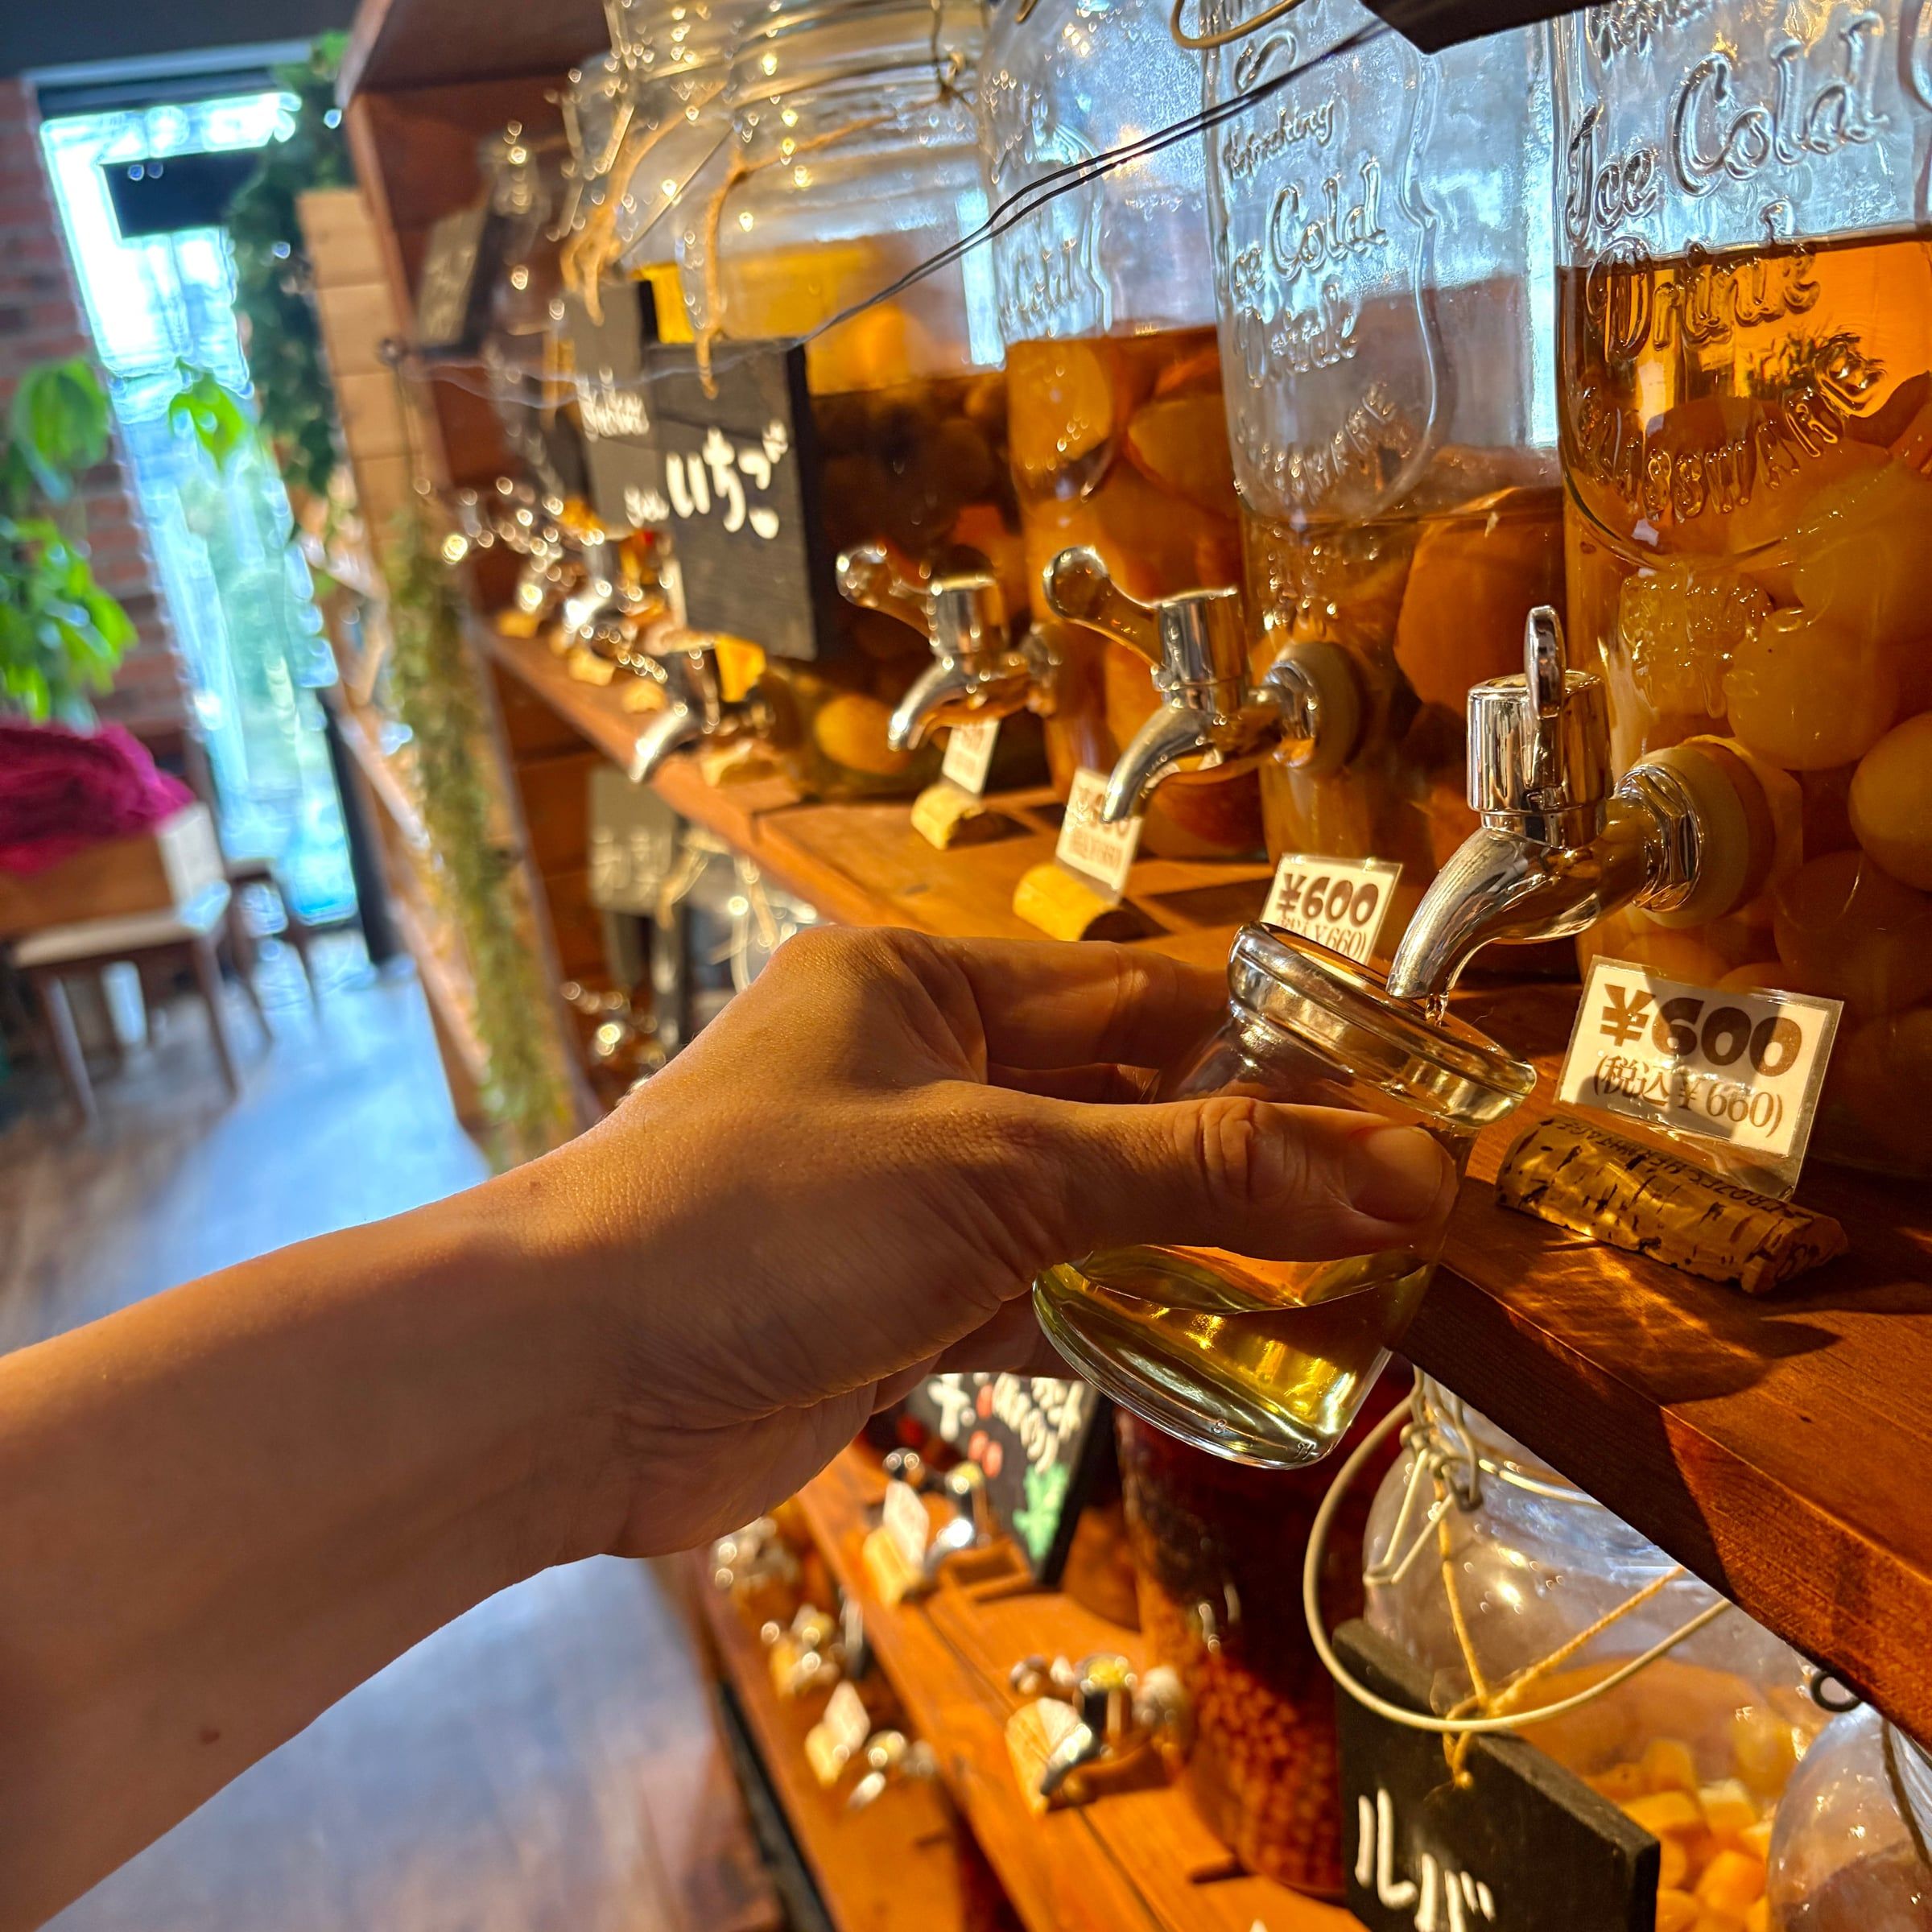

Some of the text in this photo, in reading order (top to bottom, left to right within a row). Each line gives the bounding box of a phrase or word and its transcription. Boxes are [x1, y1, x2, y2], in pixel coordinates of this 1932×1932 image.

[1670, 11, 1889, 198] Cold
[1269, 157, 1387, 282] Cold
[667, 419, 788, 540] いちご
[1276, 872, 1380, 928] ¥600
[1599, 982, 1803, 1078] ¥600
[1592, 1052, 1785, 1138] (税込¥660)
